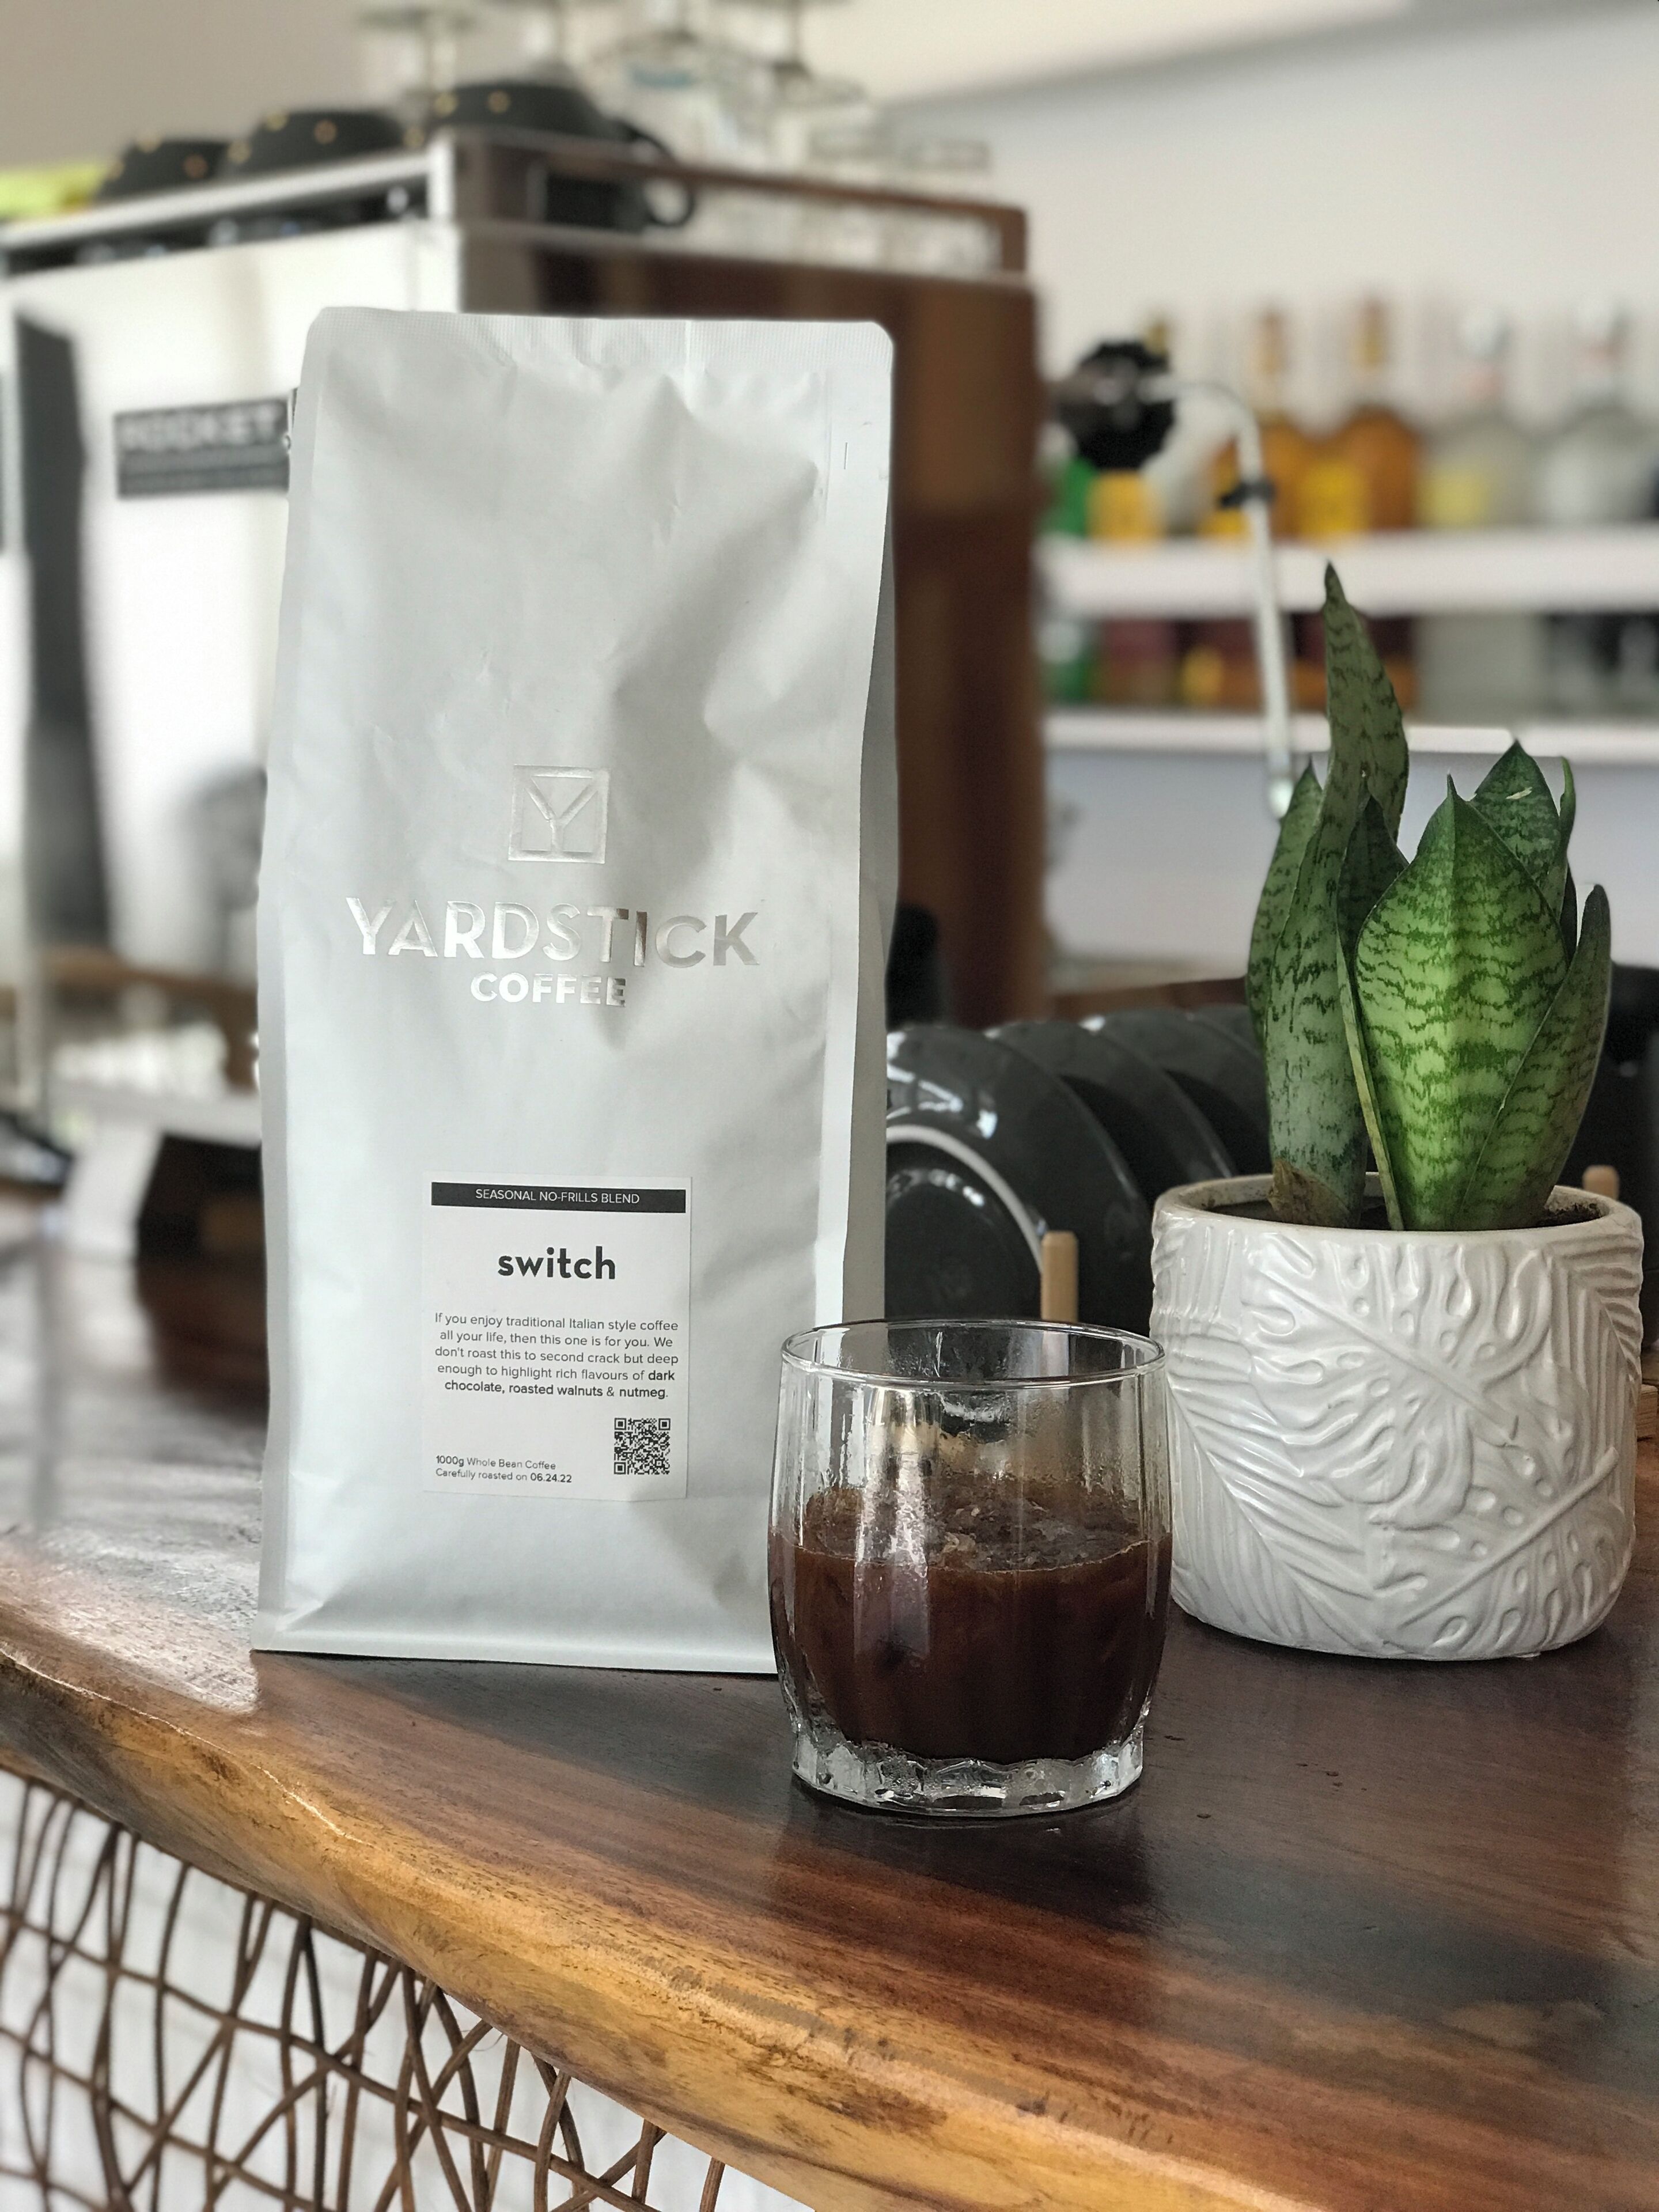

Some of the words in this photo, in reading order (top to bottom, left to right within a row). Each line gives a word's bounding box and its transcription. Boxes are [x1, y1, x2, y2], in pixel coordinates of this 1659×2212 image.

[346, 897, 760, 968] YARDSTICK
[470, 972, 627, 1008] COFFEE
[475, 1188, 536, 1201] SEASONAL
[539, 1191, 598, 1203] NO-FRILLS
[601, 1193, 639, 1204] BLEND
[498, 1245, 616, 1279] switch
[435, 1312, 442, 1323] If
[445, 1316, 467, 1325] you
[470, 1315, 503, 1328] enjoy
[506, 1316, 565, 1328] traditional
[569, 1318, 604, 1330] Italian
[608, 1320, 637, 1332] style
[640, 1320, 679, 1331] coffee
[440, 1330, 453, 1340] all
[456, 1332, 483, 1343] your
[486, 1331, 507, 1343] life,
[510, 1333, 536, 1343] then
[540, 1334, 561, 1344] this
[565, 1337, 588, 1346] one
[592, 1336, 601, 1346] is
[605, 1336, 622, 1346] for
[624, 1339, 649, 1349] you.
[654, 1336, 673, 1347] We
[435, 1346, 464, 1357] don't
[468, 1349, 497, 1359] roast
[500, 1349, 521, 1359] this
[525, 1350, 536, 1361] to
[540, 1352, 584, 1362] second
[588, 1353, 620, 1363] crack
[624, 1353, 643, 1363] but
[647, 1354, 679, 1366] deep
[437, 1364, 482, 1377] enough
[486, 1366, 498, 1376] to
[501, 1366, 552, 1380] highlight
[555, 1369, 577, 1379] rich
[581, 1369, 628, 1380] flavours
[632, 1370, 645, 1381] of
[648, 1370, 675, 1381] dark
[445, 1380, 505, 1394] chocolate,
[509, 1384, 554, 1395] roasted
[557, 1385, 603, 1396] walnuts
[607, 1387, 615, 1397] &
[619, 1387, 668, 1400] nutmeg.
[435, 1455, 464, 1467] 1000g
[467, 1457, 497, 1467] Whole
[499, 1459, 522, 1468] Bean
[525, 1460, 556, 1470] Coffee
[435, 1468, 476, 1480] Carefully
[478, 1472, 513, 1480] roasted
[530, 1472, 572, 1483] 06.24.22
